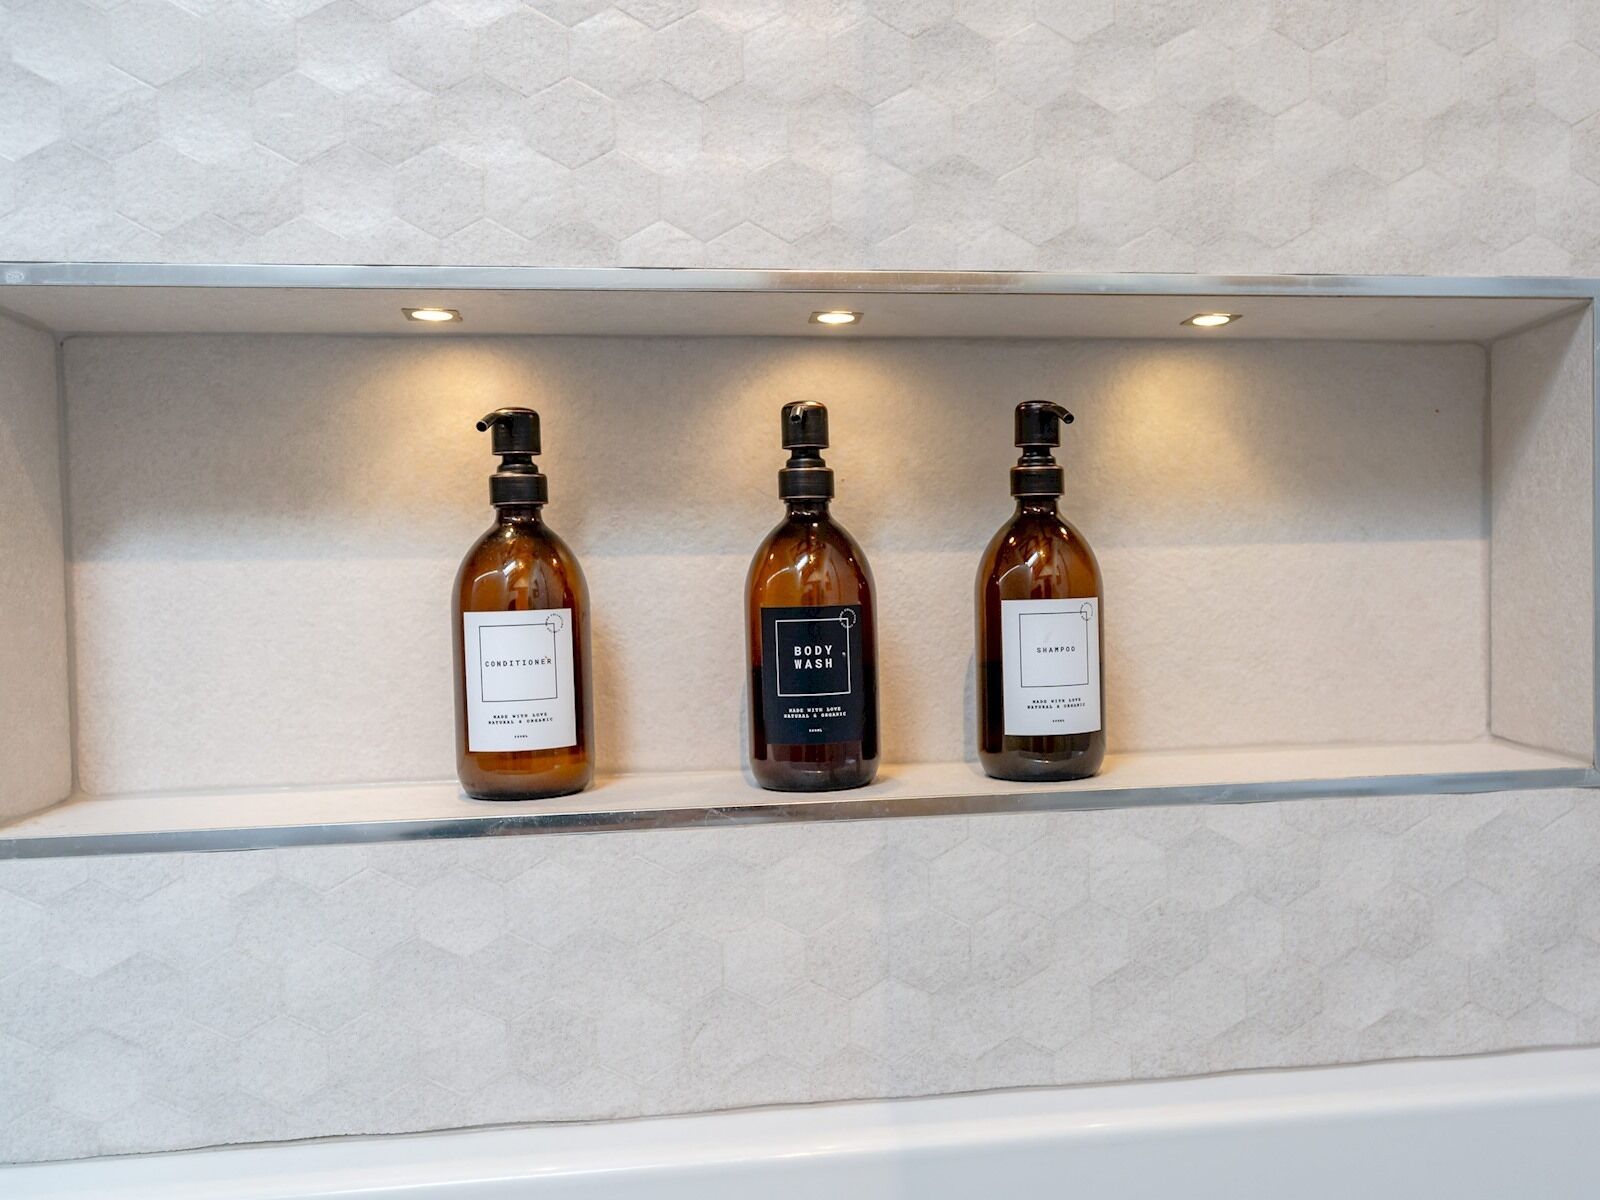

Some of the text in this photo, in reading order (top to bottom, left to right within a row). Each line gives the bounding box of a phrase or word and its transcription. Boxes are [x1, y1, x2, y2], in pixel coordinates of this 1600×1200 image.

[794, 645, 832, 656] BODY
[485, 658, 552, 667] CONDITIONER
[794, 658, 832, 669] WASH
